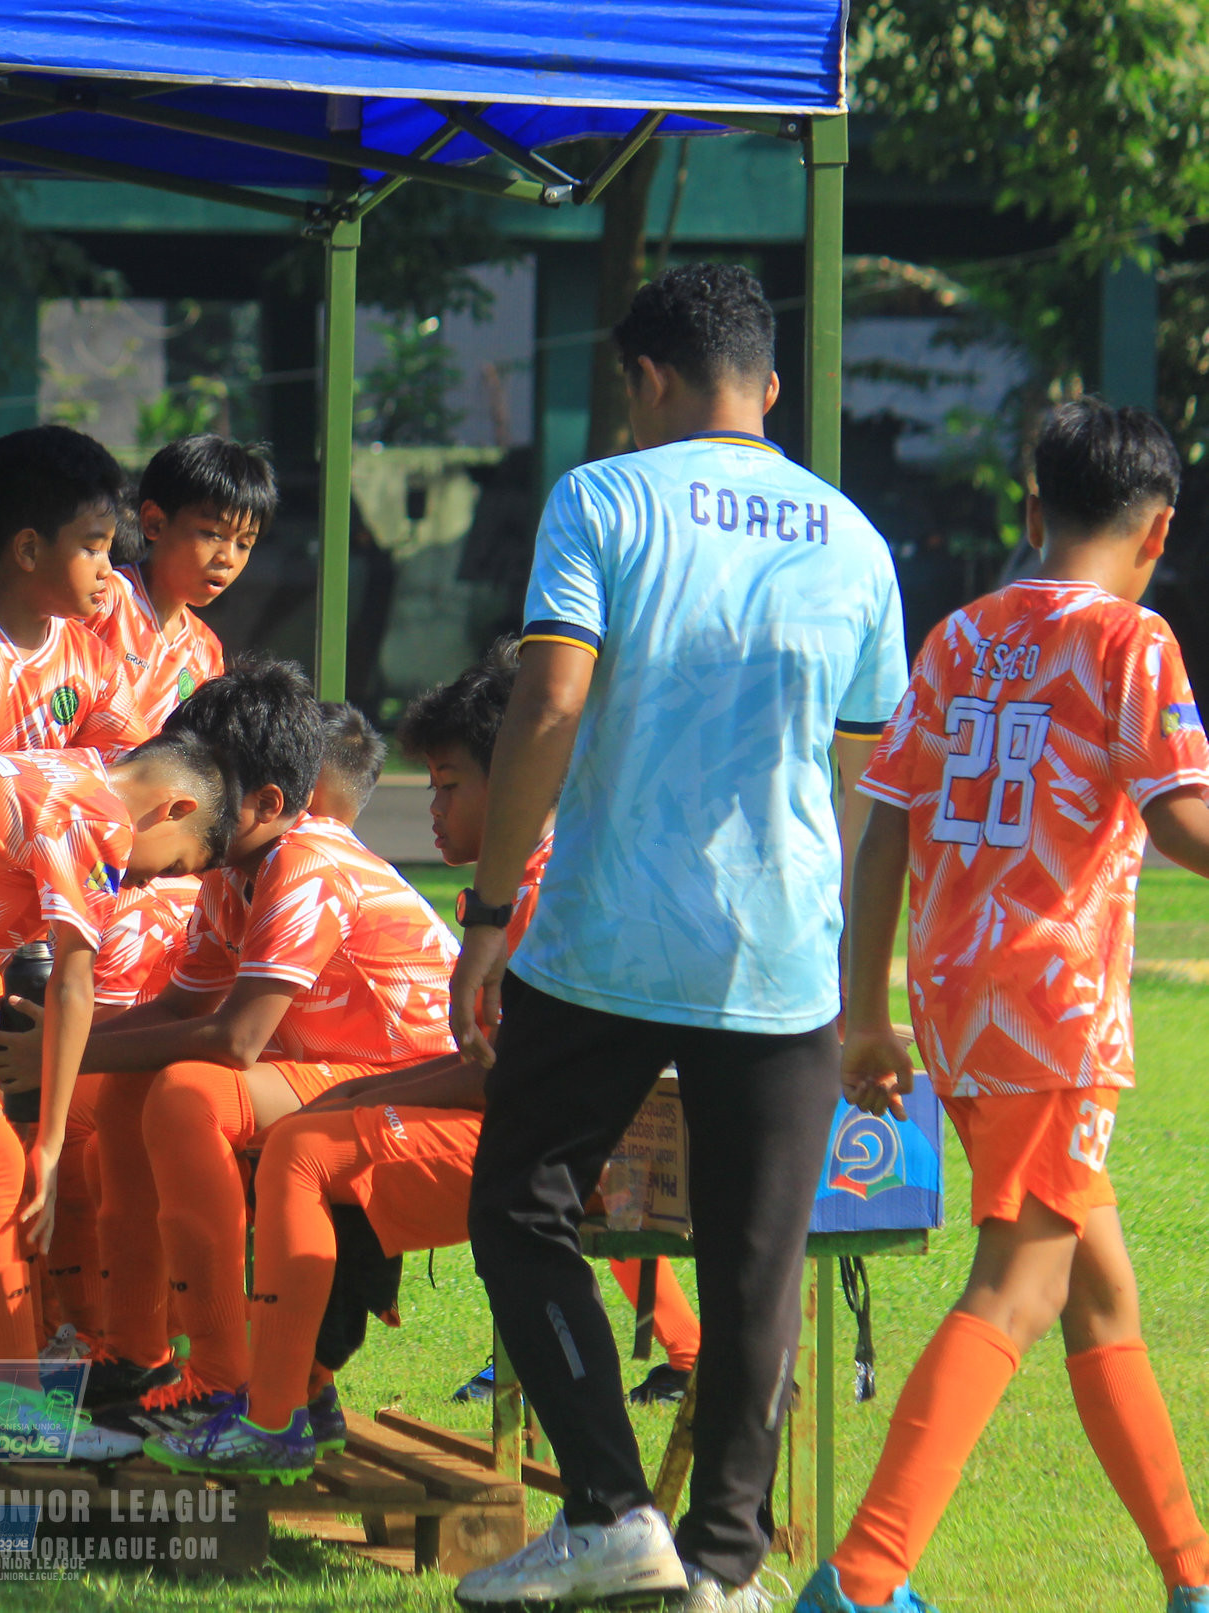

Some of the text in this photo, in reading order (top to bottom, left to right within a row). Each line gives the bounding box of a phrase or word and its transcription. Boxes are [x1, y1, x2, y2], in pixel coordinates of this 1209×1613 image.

[689, 481, 829, 545] COACH
[971, 638, 1041, 682] ISCO
[932, 695, 1054, 849] 28
[1068, 1099, 1116, 1174] 28
